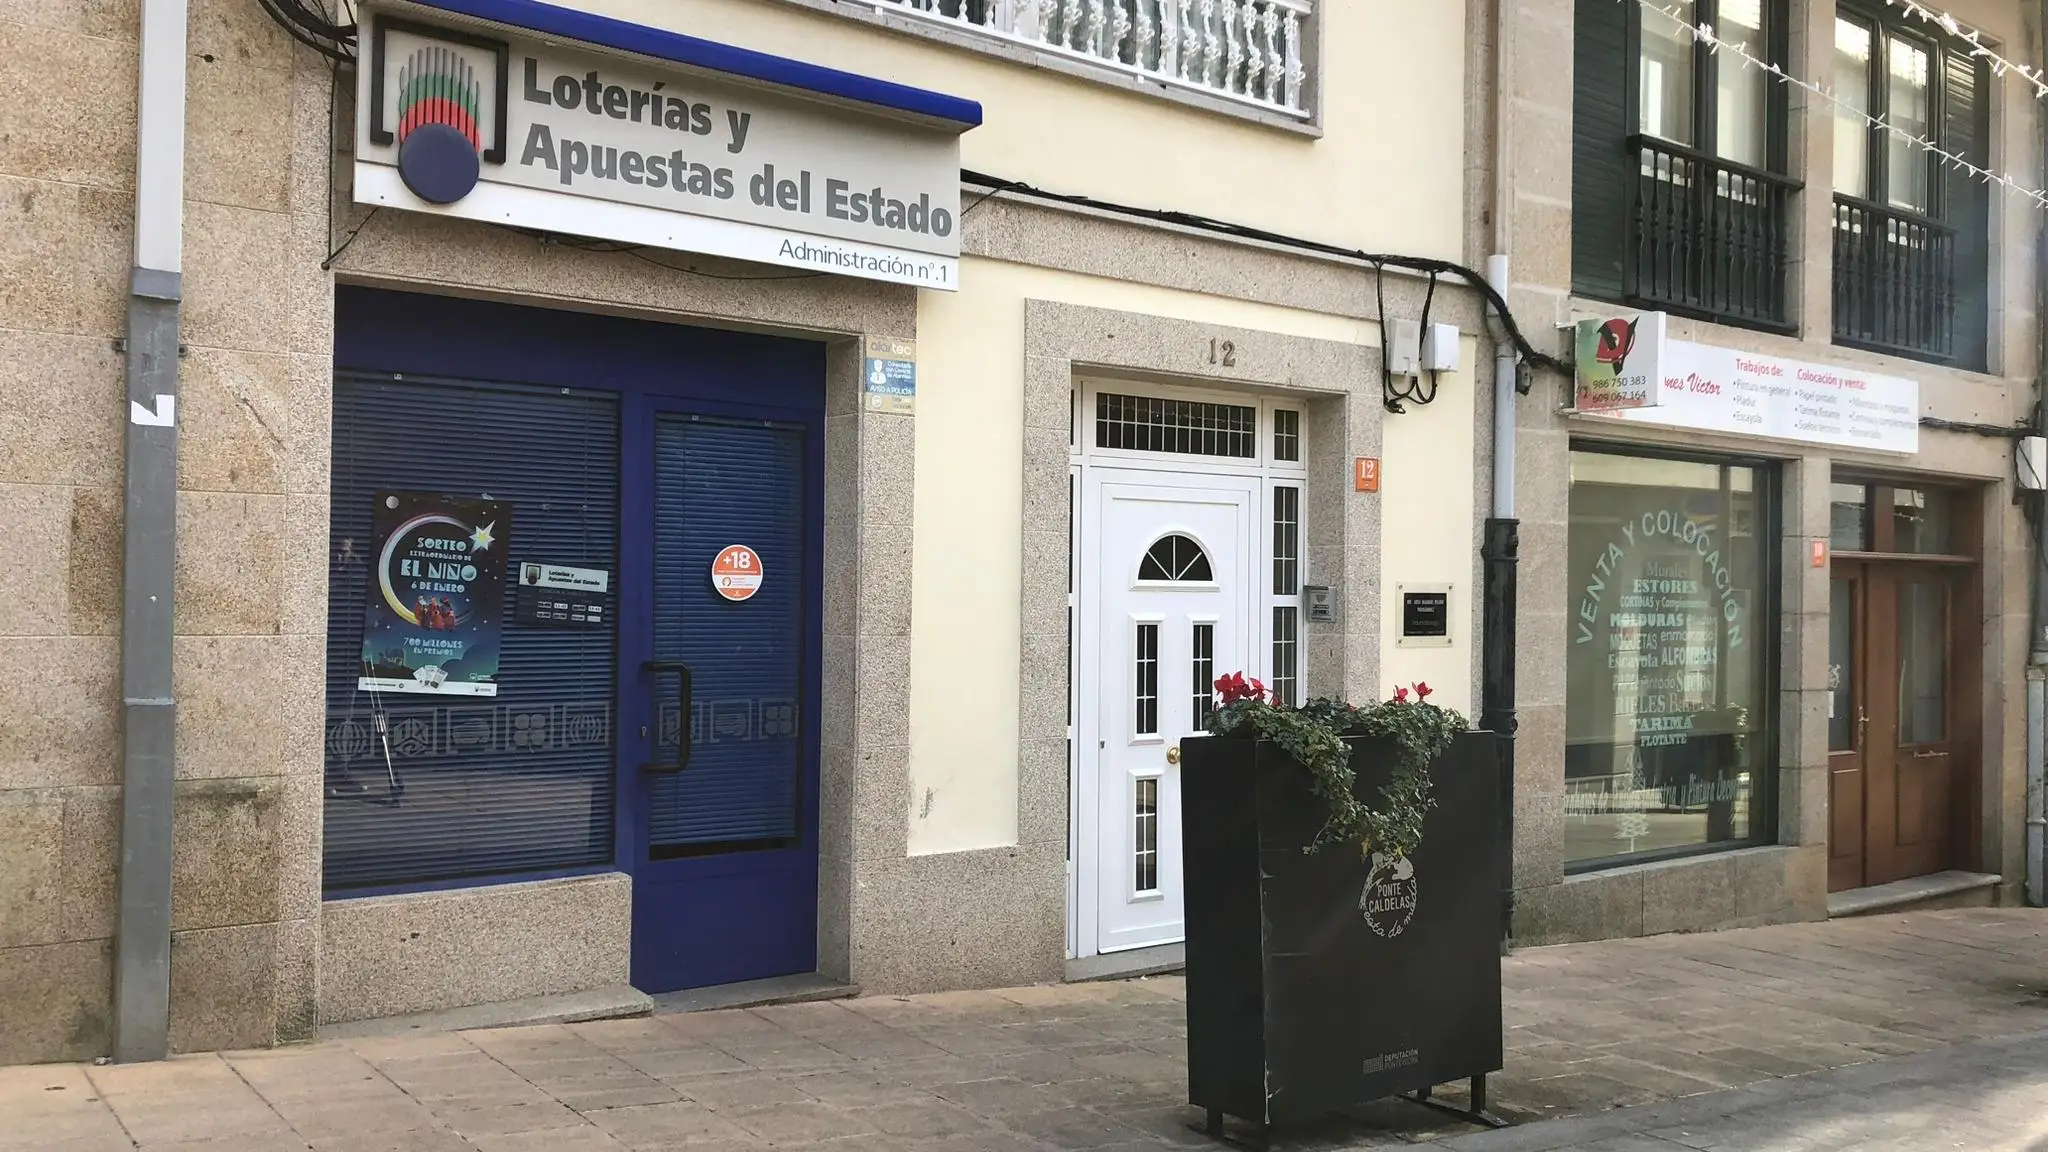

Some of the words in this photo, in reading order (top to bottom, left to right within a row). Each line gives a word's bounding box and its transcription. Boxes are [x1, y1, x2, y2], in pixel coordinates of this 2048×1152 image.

[523, 57, 712, 135] Loterías
[726, 111, 751, 154] y
[520, 122, 735, 199] Apuestas
[750, 163, 811, 214] del
[826, 178, 953, 238] Estado
[778, 238, 914, 279] Administración
[1209, 337, 1236, 367] 12
[1736, 358, 1769, 377] Trabajos
[1770, 364, 1784, 377] de:
[1592, 377, 1609, 390] 986
[1611, 377, 1628, 387] 750
[1629, 375, 1647, 386] 383
[1797, 368, 1837, 386] Colocación
[1838, 377, 1844, 389] y
[1610, 391, 1627, 402] 067
[1628, 390, 1646, 401] 164
[1361, 460, 1375, 479] 12
[417, 537, 467, 551] SORTEO
[723, 551, 751, 569] +18
[400, 558, 422, 577] EL
[427, 562, 477, 582] NIÑO
[411, 581, 417, 589] 6
[420, 581, 431, 590] DE
[434, 582, 465, 593] ENERO
[1576, 541, 1624, 644] VENTA
[1622, 520, 1635, 546] Y
[1632, 578, 1698, 594] ESTORES
[1609, 613, 1684, 627] MOLDURAS
[1615, 695, 1666, 714] RIELES
[1630, 716, 1694, 732] TARIMA
[1640, 733, 1687, 747] FLOTANTE
[1378, 882, 1402, 898] PONTE
[1368, 896, 1410, 913] CALDELAS
[1388, 920, 1404, 938] de
